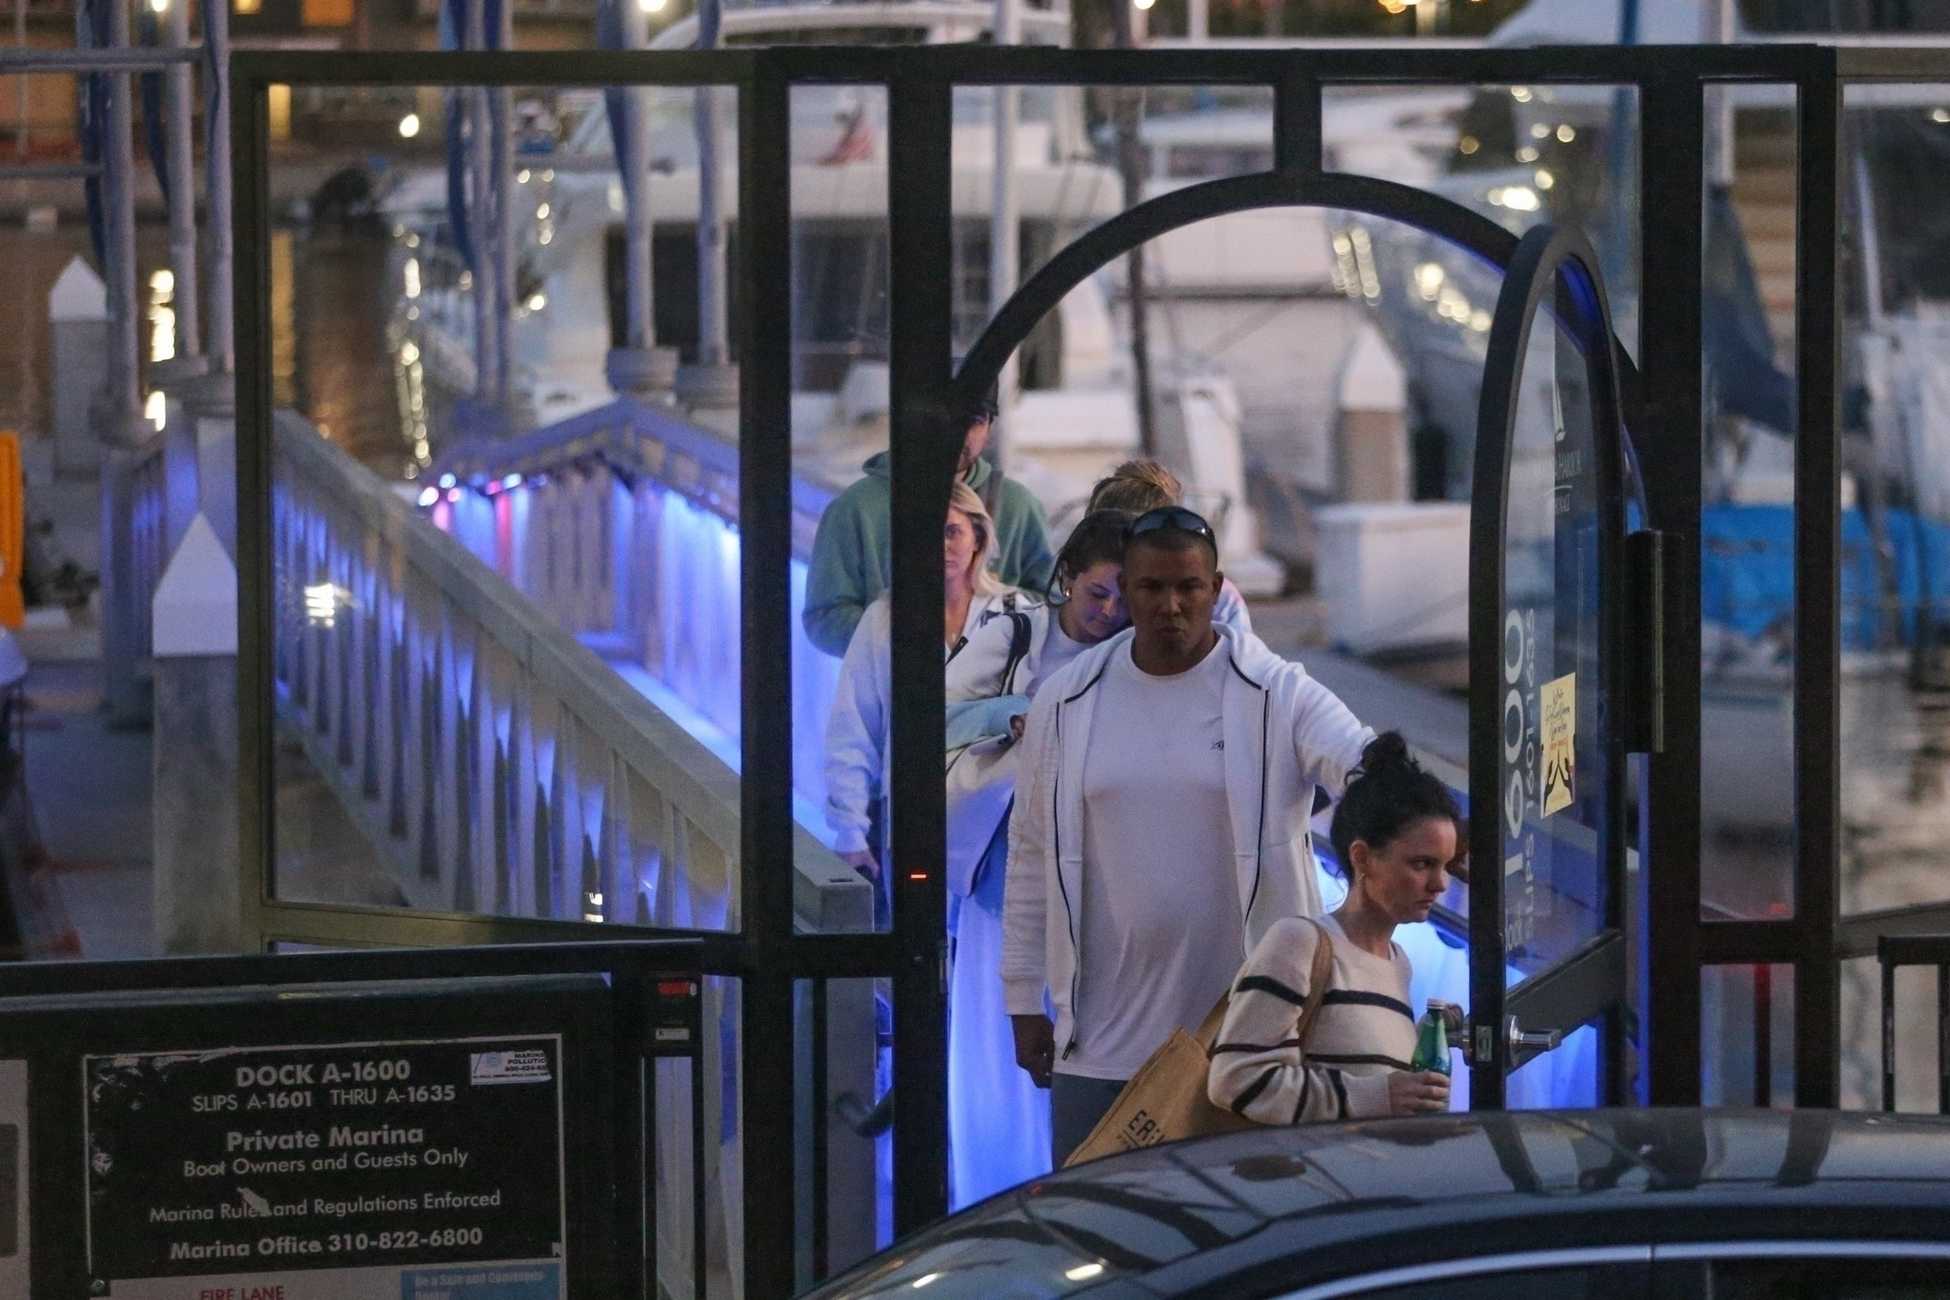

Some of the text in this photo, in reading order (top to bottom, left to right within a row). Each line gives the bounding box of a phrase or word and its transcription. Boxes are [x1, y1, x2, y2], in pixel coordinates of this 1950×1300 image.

[236, 1060, 411, 1088] DOCK A-1600
[192, 1085, 456, 1113] SLIPS A-1601 THRU A-1635
[227, 1124, 424, 1152] Private Marina
[183, 1147, 469, 1178] Boat Owners and Guests Only
[149, 1189, 501, 1223] Marina Rule and Regulations Enforced
[170, 1227, 483, 1260] Marina Office 310-822-6800
[200, 1286, 285, 1300] FIRE LANE
